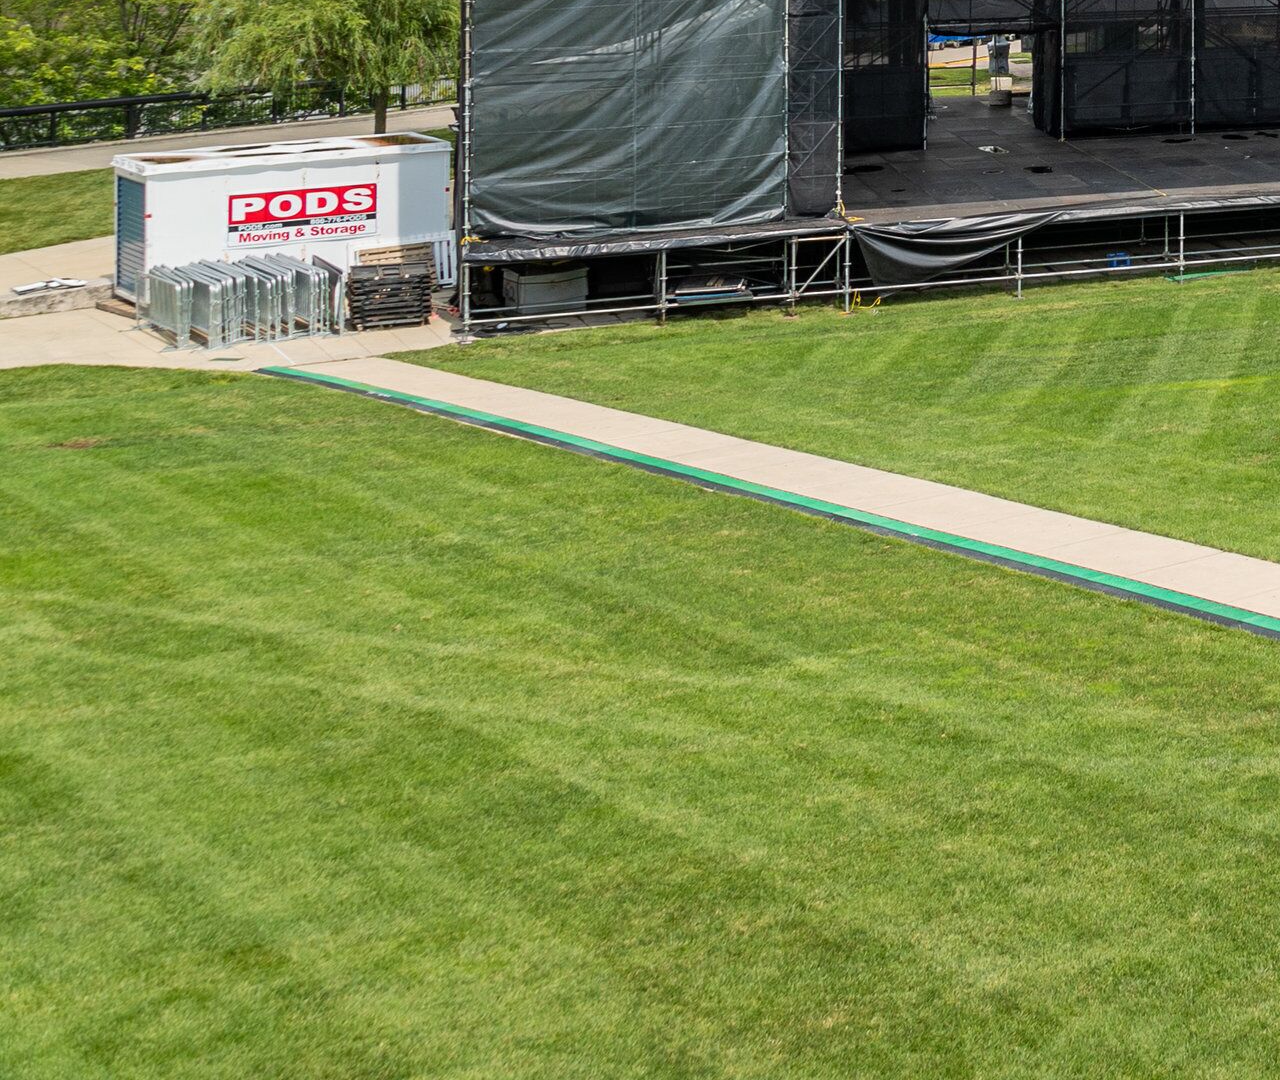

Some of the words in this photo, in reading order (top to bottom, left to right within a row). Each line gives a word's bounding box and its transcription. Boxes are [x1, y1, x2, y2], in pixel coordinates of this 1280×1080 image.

[231, 188, 373, 222] PODS
[237, 222, 283, 232] PODS.com
[238, 230, 290, 243] Moving
[295, 227, 305, 238] &
[310, 223, 366, 236] Storage
